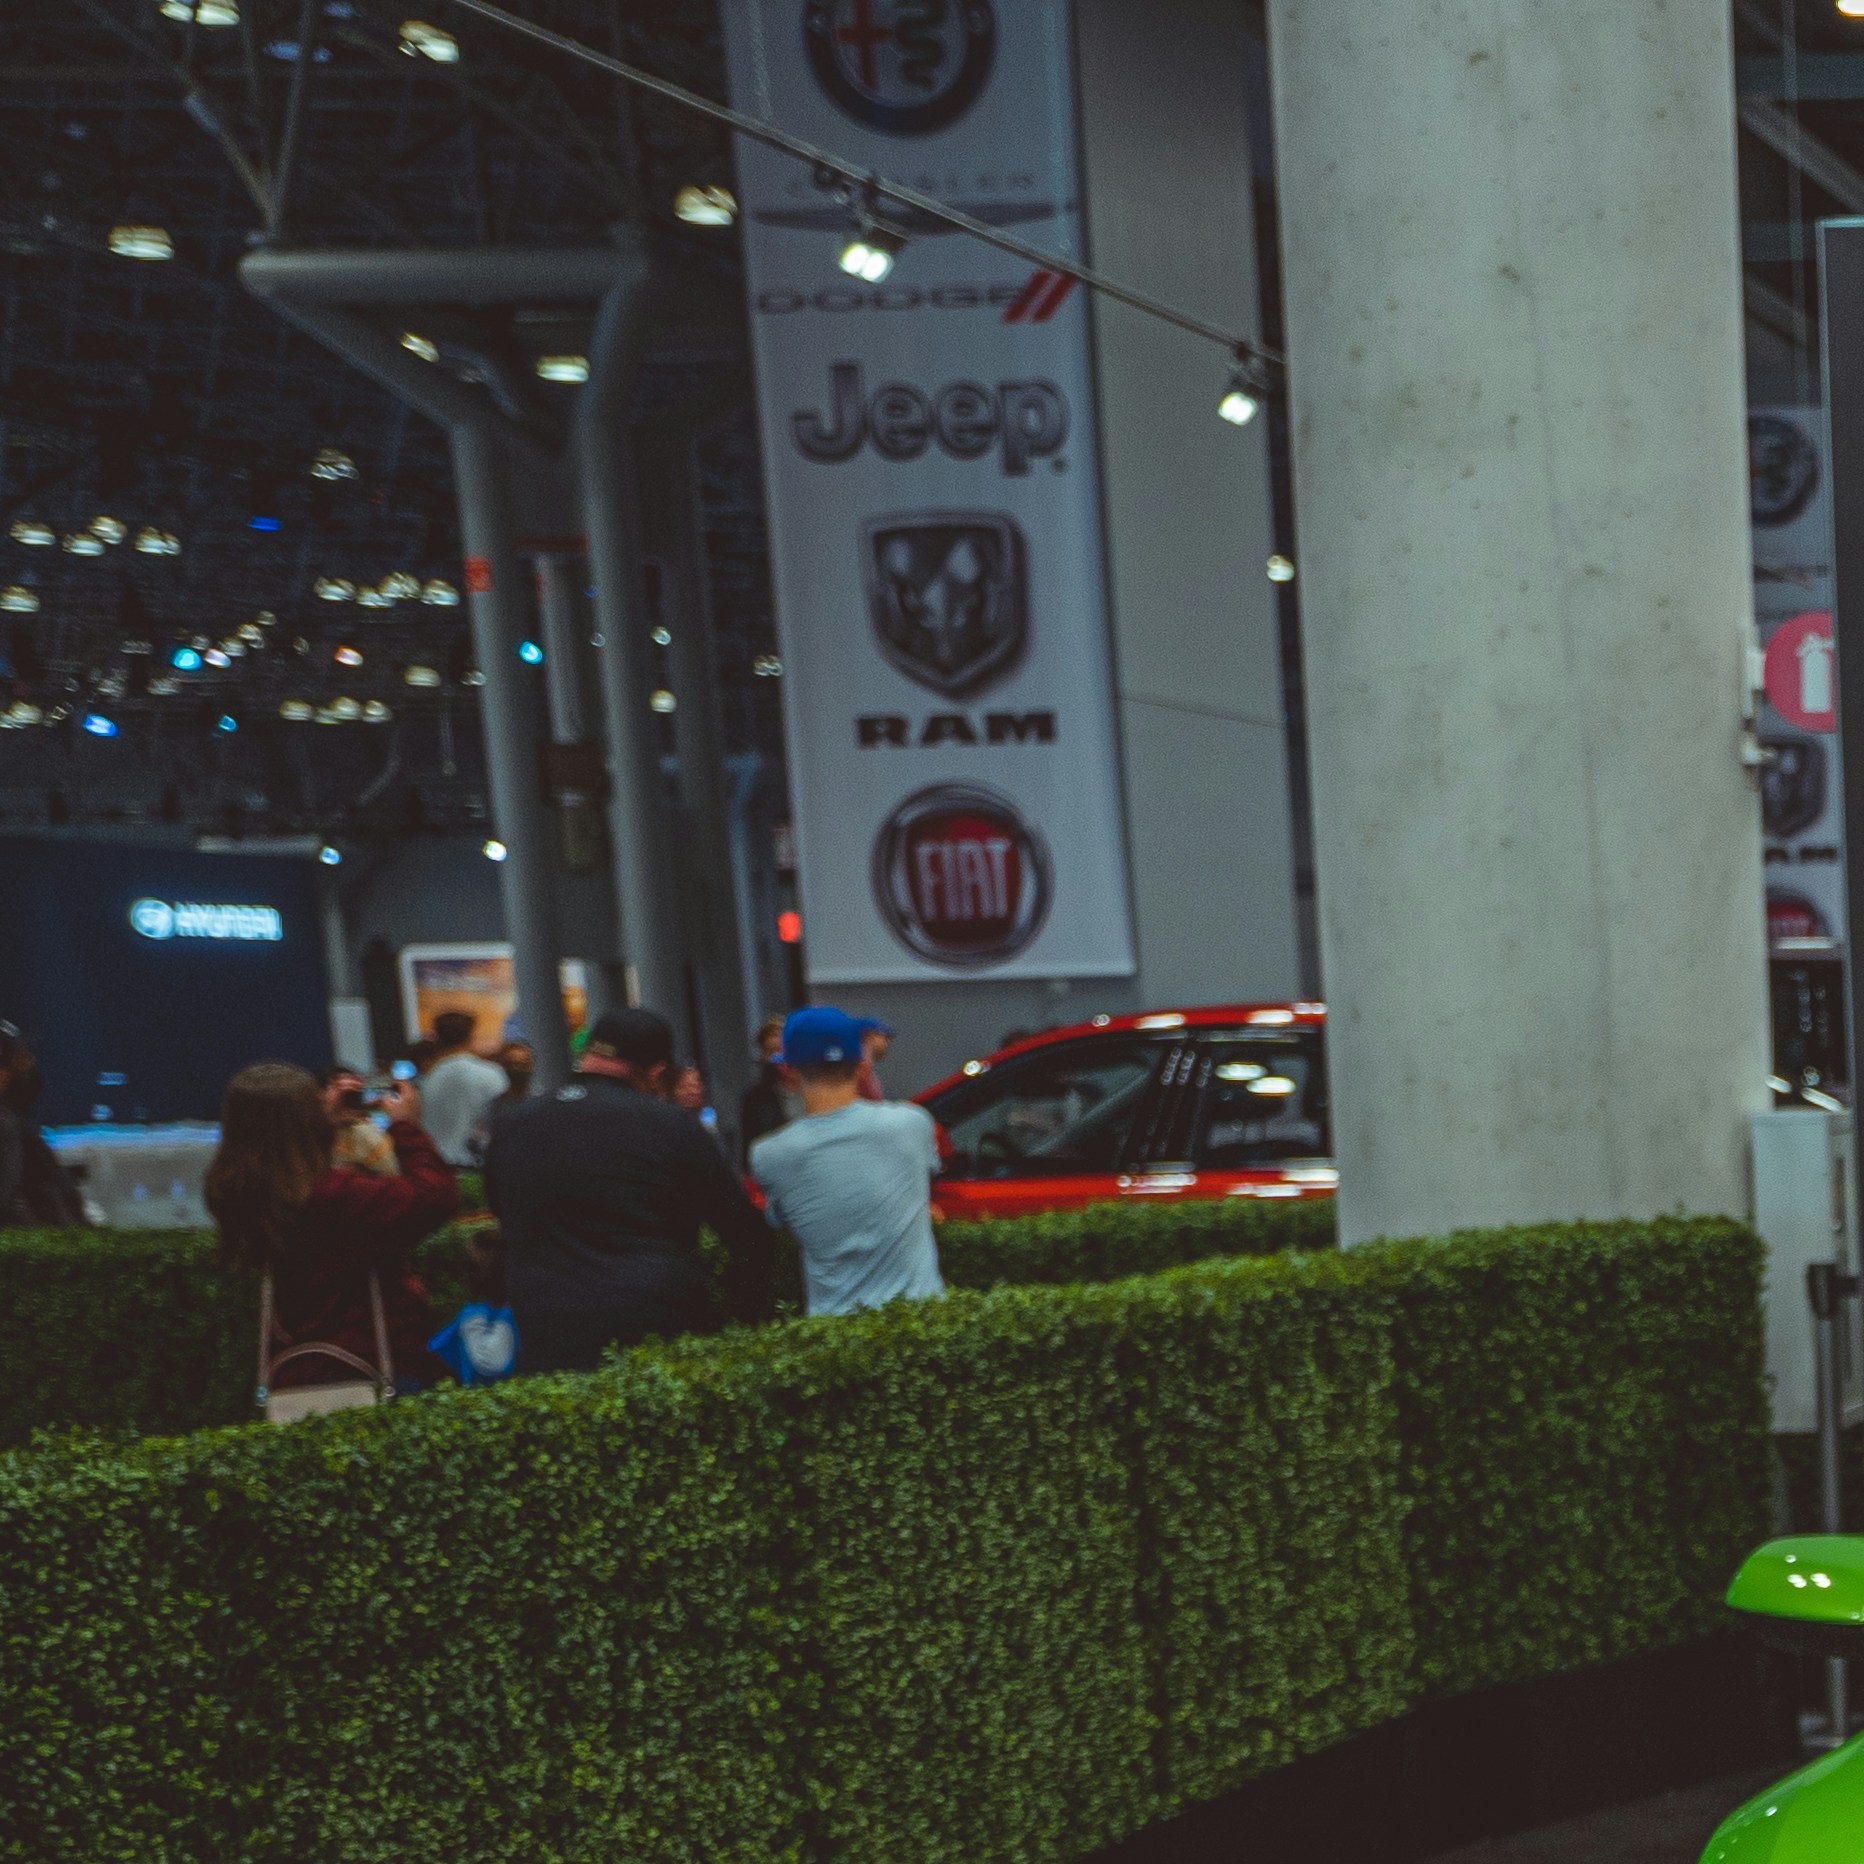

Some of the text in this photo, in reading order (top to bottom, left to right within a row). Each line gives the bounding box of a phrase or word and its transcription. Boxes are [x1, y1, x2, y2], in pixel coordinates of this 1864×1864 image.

[792, 361, 1070, 477] Jeep
[855, 710, 1057, 749] RAM
[914, 837, 1014, 922] FIAT
